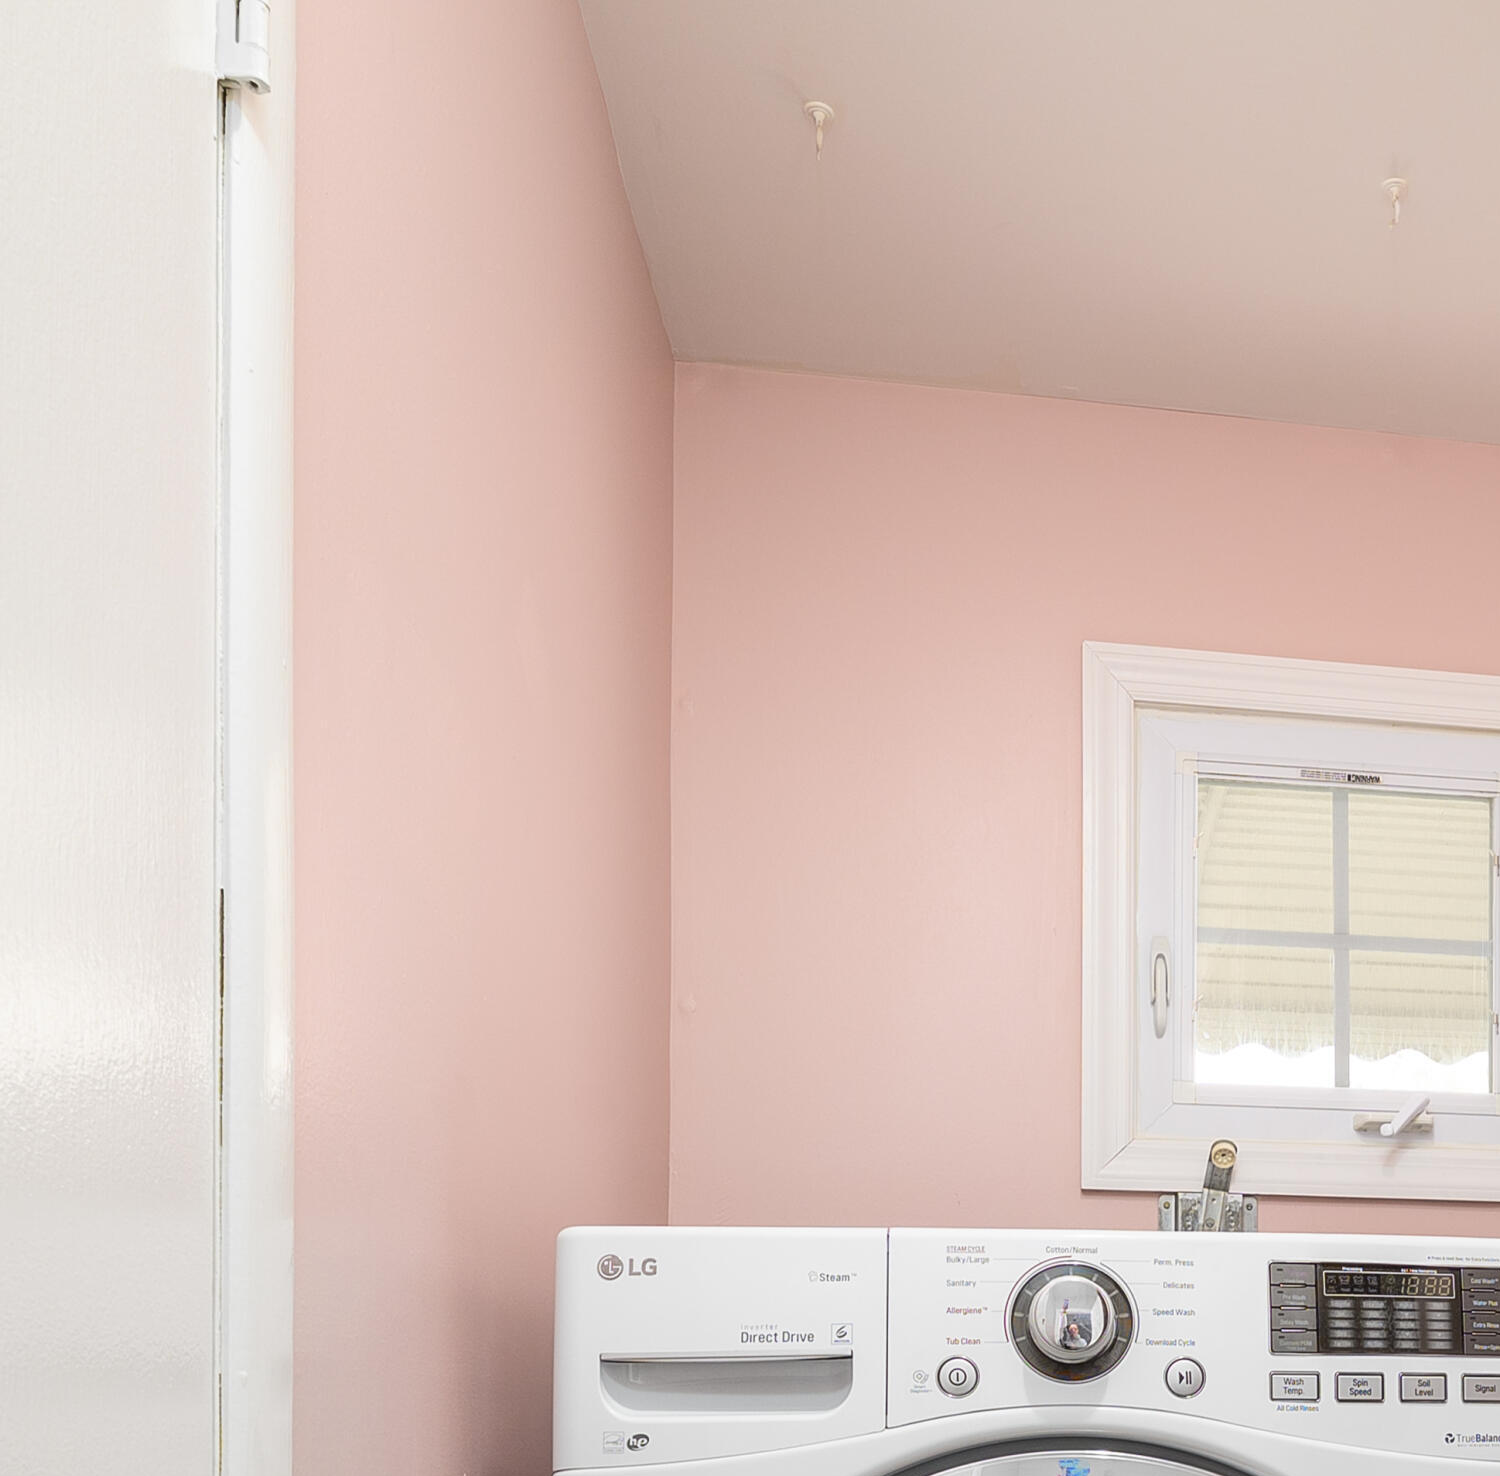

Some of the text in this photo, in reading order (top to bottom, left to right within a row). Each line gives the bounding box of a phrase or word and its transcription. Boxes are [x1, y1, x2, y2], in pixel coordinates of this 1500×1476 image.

[1045, 1246, 1098, 1254] Cotton/Normal
[946, 1256, 990, 1264] Bulky/Large
[1175, 1259, 1194, 1267] Press
[628, 1257, 657, 1277] LG
[946, 1279, 976, 1288] Sanitary
[1162, 1281, 1195, 1289] Delicates
[1152, 1308, 1196, 1316] Speed Wash
[741, 1331, 815, 1344] Direct Drive
[946, 1337, 981, 1345] Tub Clean
[1145, 1338, 1195, 1348] Download Cycle
[1283, 1377, 1305, 1386] Wash
[1352, 1378, 1369, 1388] Spin
[1417, 1379, 1431, 1387] Soil
[1349, 1387, 1372, 1397] Speed
[1414, 1388, 1434, 1397] Level
[1474, 1383, 1497, 1394] Signal
